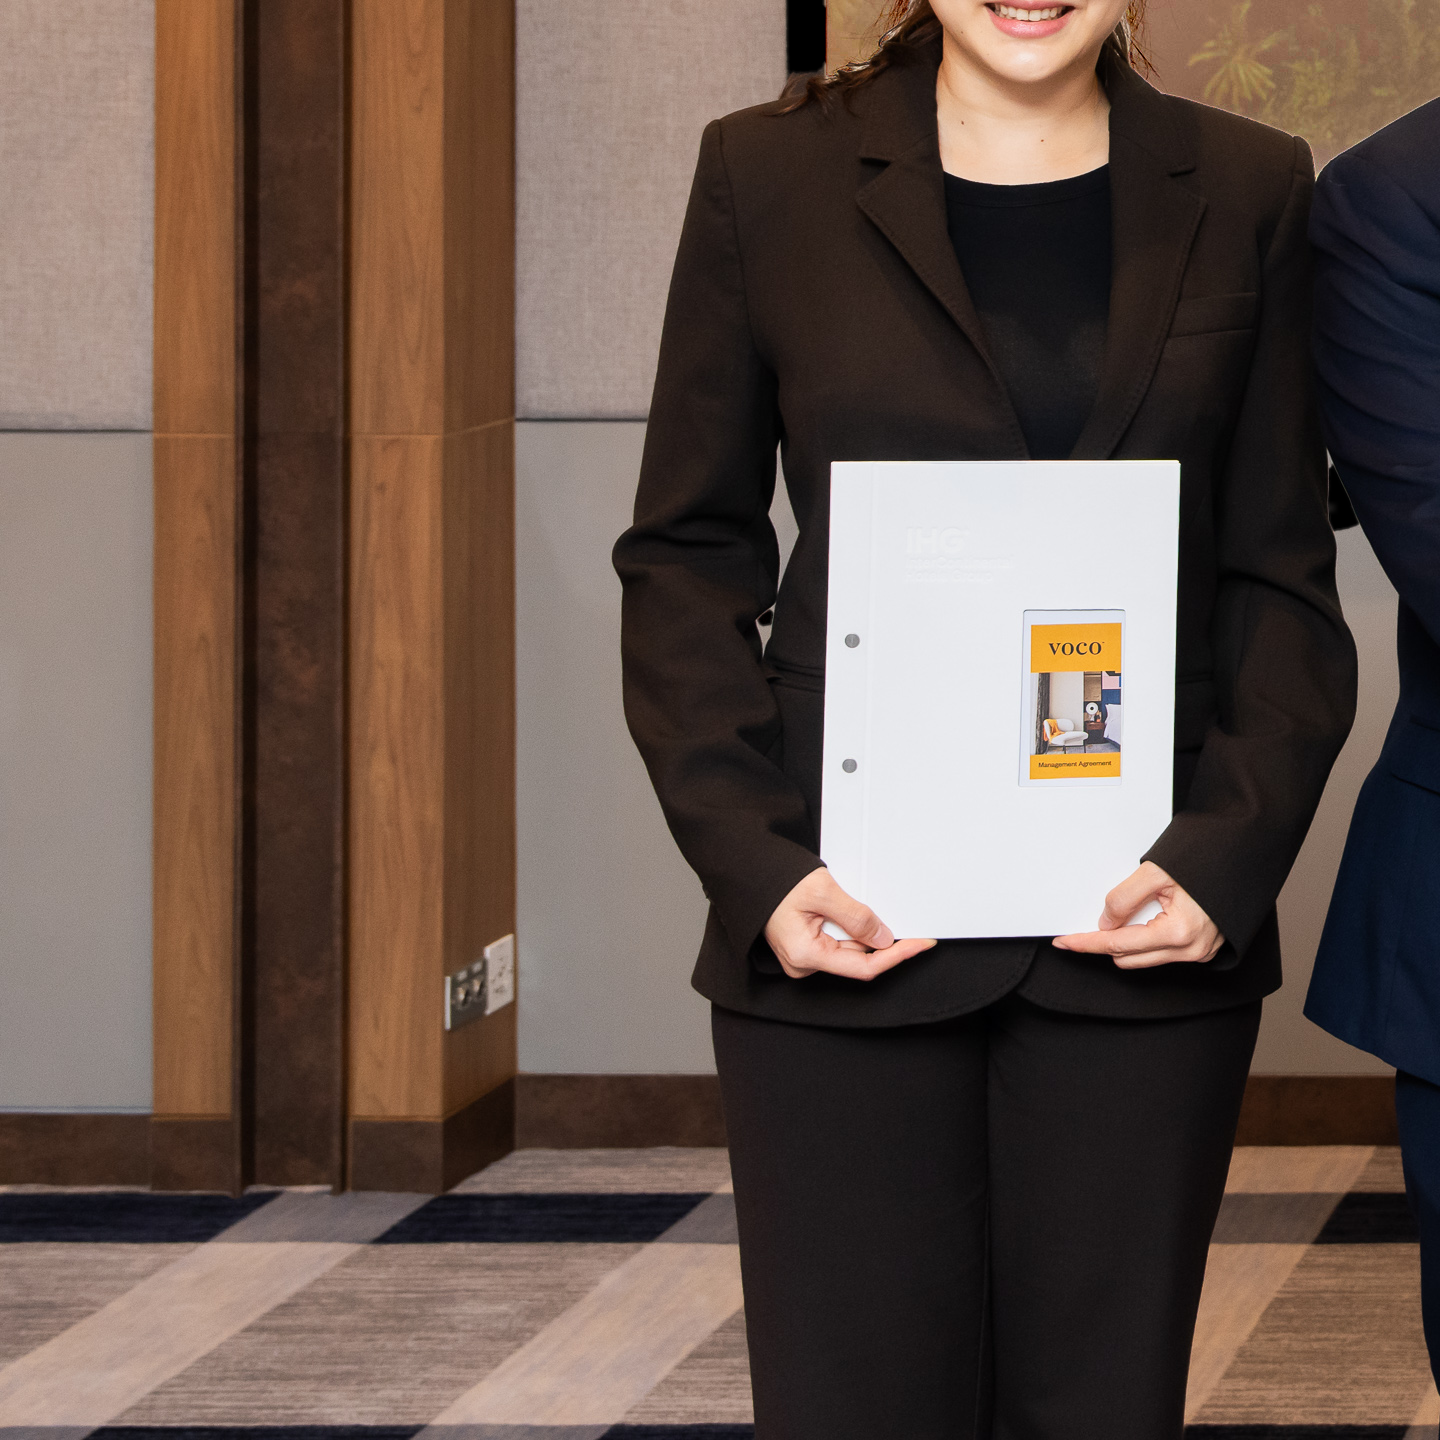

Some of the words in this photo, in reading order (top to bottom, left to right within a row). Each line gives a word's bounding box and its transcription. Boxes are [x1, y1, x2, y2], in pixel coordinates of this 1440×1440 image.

[906, 526, 966, 554] IHG
[1038, 761, 1077, 769] Management
[1078, 760, 1112, 768] Agreement
